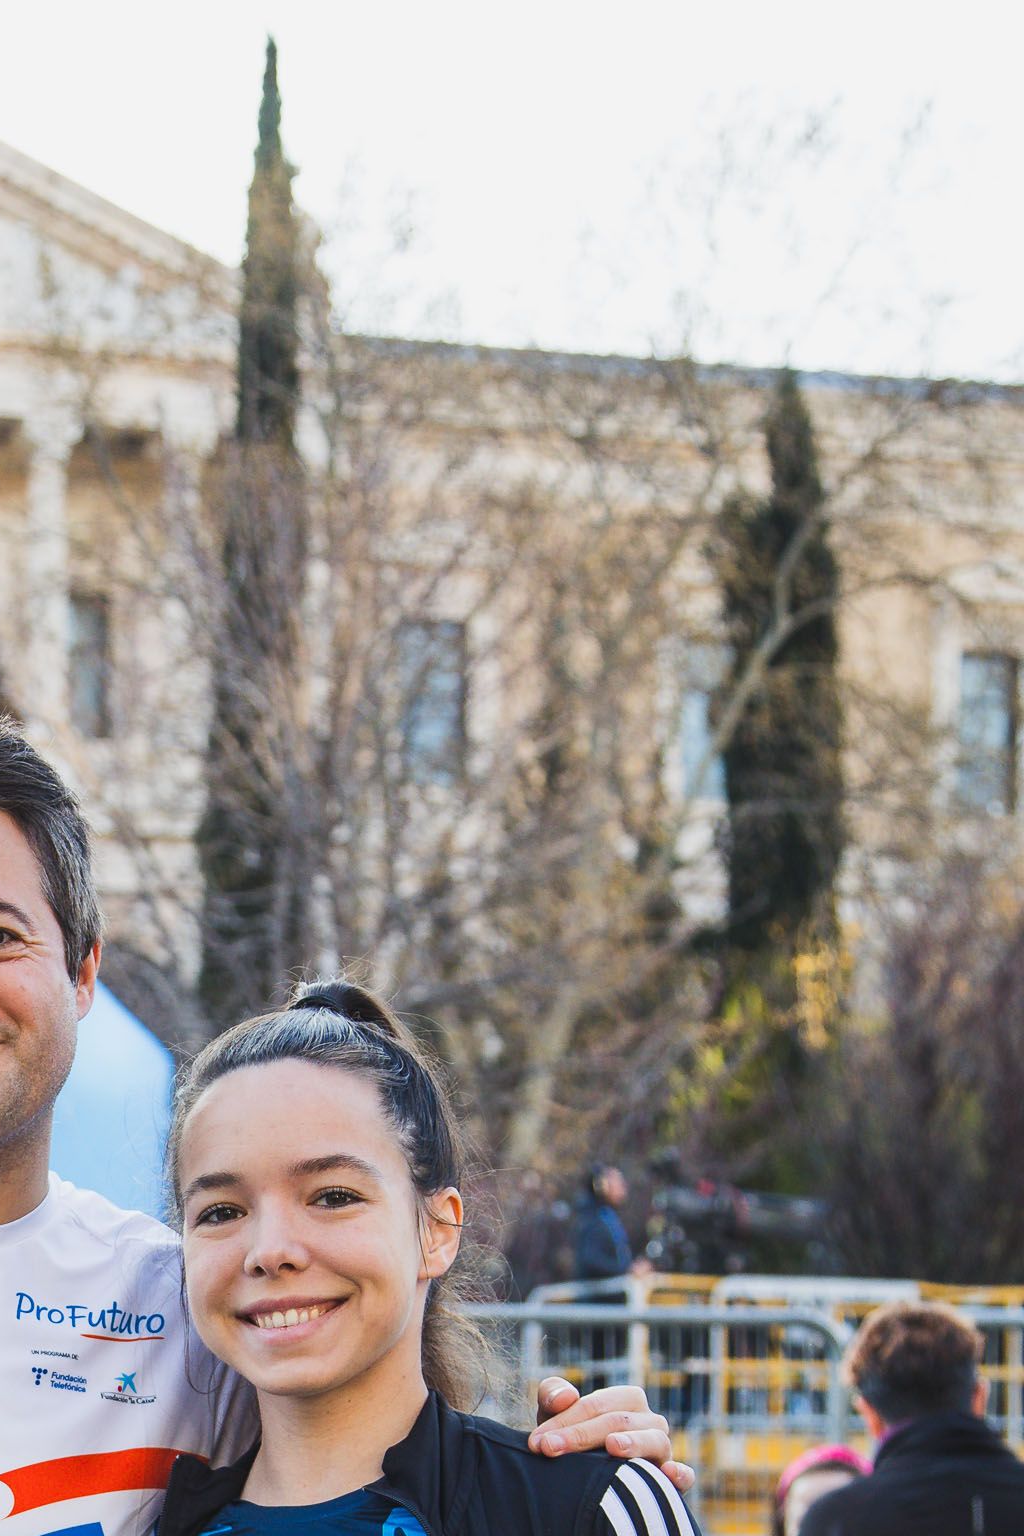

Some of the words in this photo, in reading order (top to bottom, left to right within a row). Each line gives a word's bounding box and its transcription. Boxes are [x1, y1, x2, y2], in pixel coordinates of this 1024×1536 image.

[16, 1292, 165, 1335] ProFuturo
[40, 1350, 70, 1358] PROGRAMA
[51, 1371, 87, 1384] Fundación
[50, 1380, 86, 1393] Telefónica
